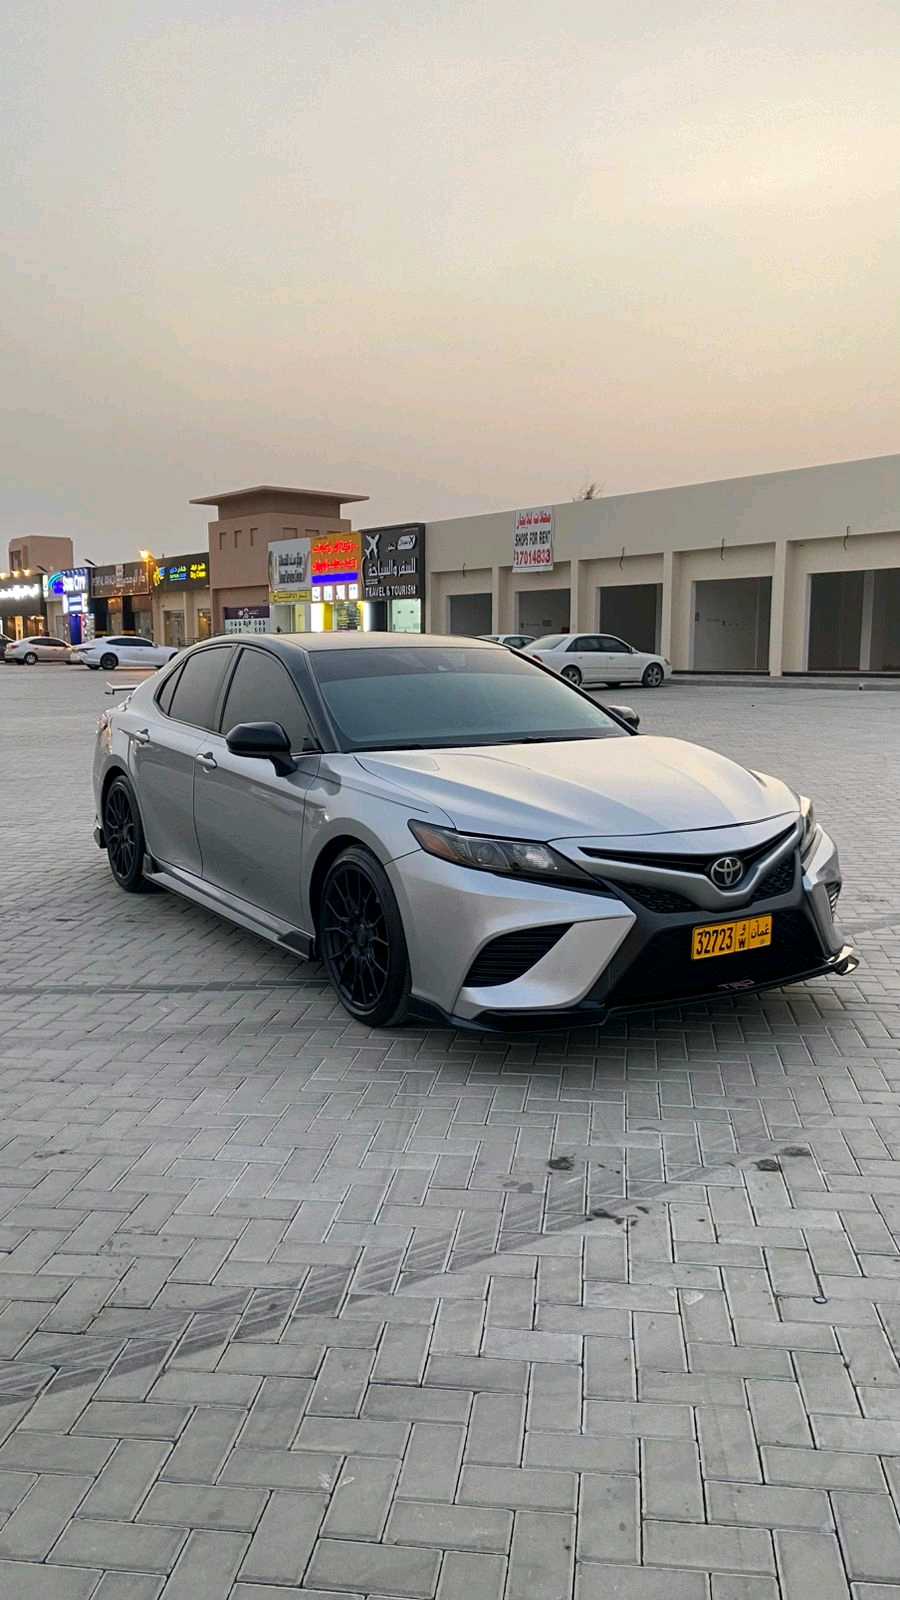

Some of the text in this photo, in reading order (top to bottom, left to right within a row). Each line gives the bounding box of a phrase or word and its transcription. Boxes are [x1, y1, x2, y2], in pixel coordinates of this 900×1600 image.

[515, 530, 551, 547] SHOPS FOR RENT
[368, 559, 398, 579] والسياحة
[398, 557, 416, 577] للسفر
[365, 586, 385, 598] TRAVEL
[391, 583, 416, 596] TOURISM
[695, 927, 734, 955] 32723
[738, 938, 746, 949] W
